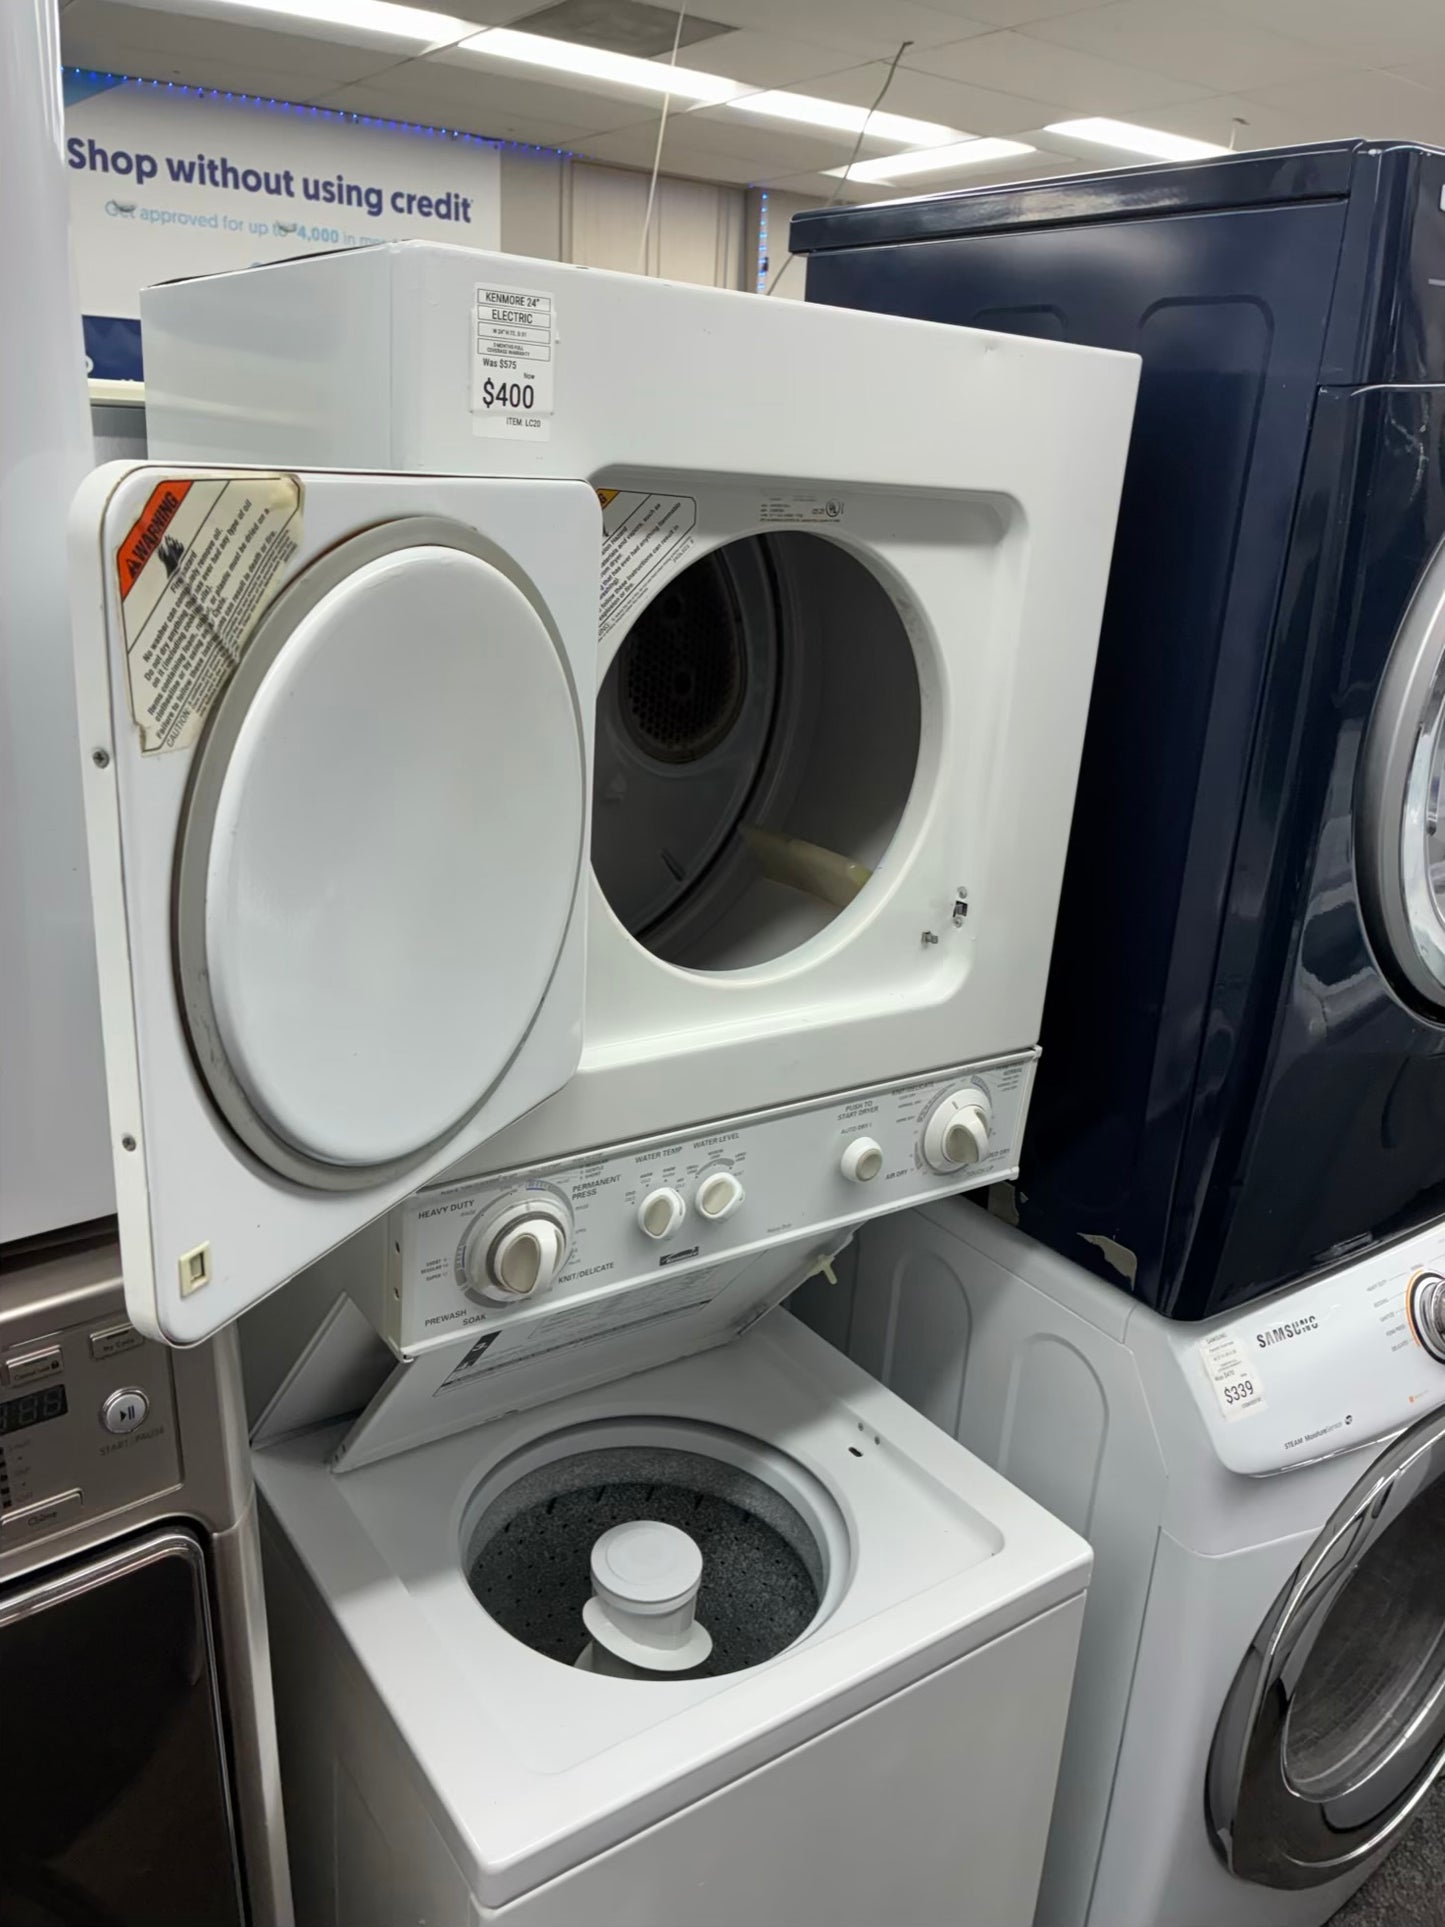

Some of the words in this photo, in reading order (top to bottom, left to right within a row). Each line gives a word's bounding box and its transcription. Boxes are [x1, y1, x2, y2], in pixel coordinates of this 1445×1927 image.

[67, 137, 158, 185] Shop
[165, 154, 294, 197] without
[303, 174, 383, 217] using
[140, 207, 218, 229] approved
[222, 216, 244, 231] for
[248, 222, 269, 236] up
[485, 292, 525, 306] KENMORE
[527, 297, 540, 307] 24"
[492, 309, 533, 324] ELECTRIC
[482, 358, 498, 367] Was
[499, 359, 517, 370] $575
[482, 377, 534, 409] $400
[132, 491, 179, 562] WARNING
[142, 648, 153, 662] No
[149, 620, 169, 650] washer
[173, 567, 201, 609] comptely
[143, 667, 154, 681] Do
[837, 1111, 857, 1121] START
[858, 1106, 879, 1117] DRYER
[845, 1103, 863, 1111] PUSH
[840, 1126, 855, 1135] AUTO
[856, 1123, 869, 1132] DRY
[693, 1137, 718, 1149] WATER
[719, 1132, 739, 1143] LEVEL
[635, 1152, 662, 1163] WATER
[663, 1146, 682, 1158] TEMP
[894, 1169, 908, 1178] DRY
[572, 1174, 622, 1193] PERMANENT
[572, 1189, 597, 1200] PRESS
[418, 1206, 449, 1220] HEAVY
[450, 1200, 475, 1212] DUTY
[558, 1262, 615, 1284] KNIT/DELICATE
[425, 1309, 467, 1326] PREWASH
[462, 1314, 487, 1326] SOAK
[1256, 1315, 1319, 1348] SAMSUNG
[1224, 1380, 1254, 1404] $339
[1284, 1437, 1303, 1450] STEAM
